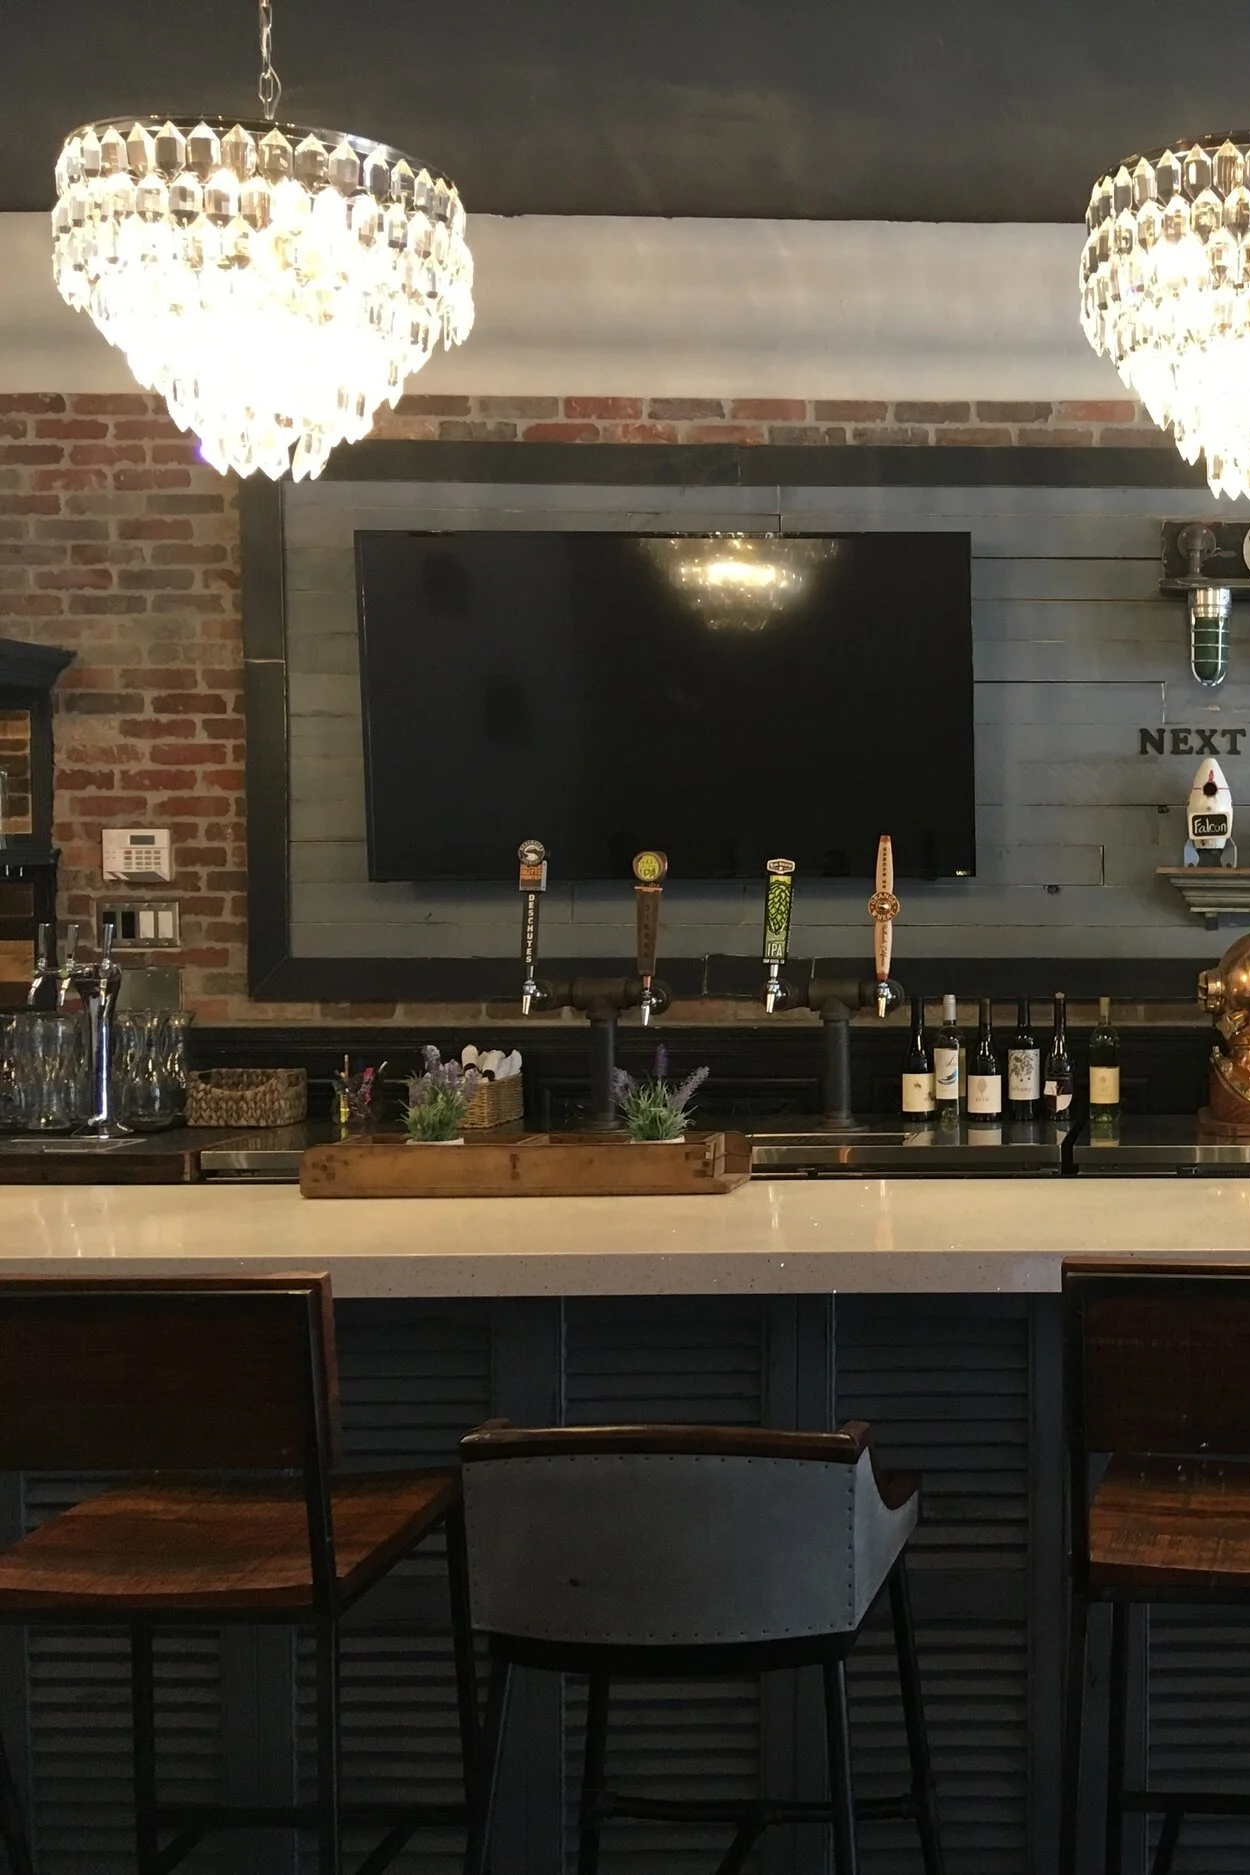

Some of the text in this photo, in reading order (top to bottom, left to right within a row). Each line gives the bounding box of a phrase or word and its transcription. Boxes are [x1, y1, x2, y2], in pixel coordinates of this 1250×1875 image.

[1139, 728, 1247, 755] NEXT
[1194, 818, 1227, 834] Falcon
[525, 894, 536, 963] DESCHUTES
[767, 942, 783, 957] IPA
